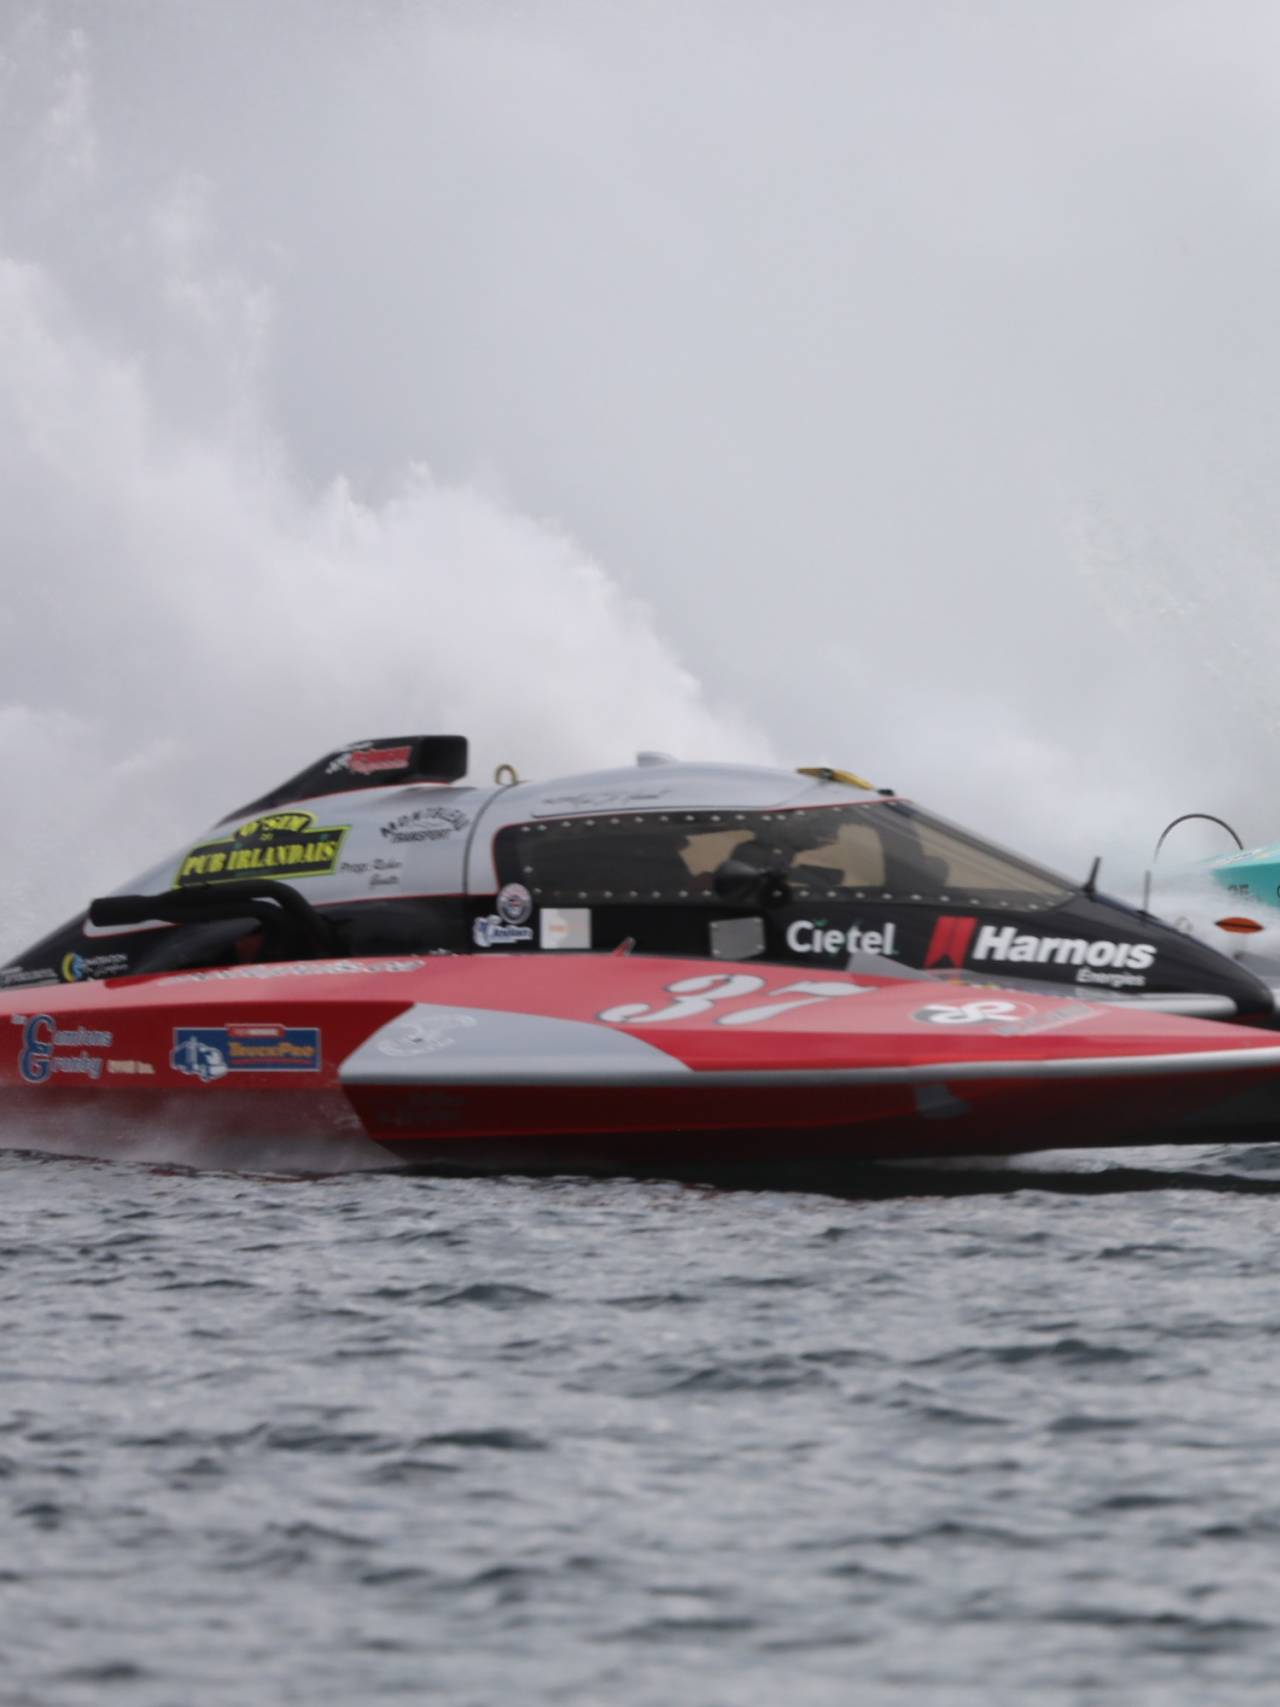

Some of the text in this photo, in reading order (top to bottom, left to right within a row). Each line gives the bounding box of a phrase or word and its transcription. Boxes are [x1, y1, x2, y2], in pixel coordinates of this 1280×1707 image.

[182, 841, 337, 876] PUB IRLANDAIS
[971, 925, 1157, 970] Harnois
[596, 973, 880, 1026] 37
